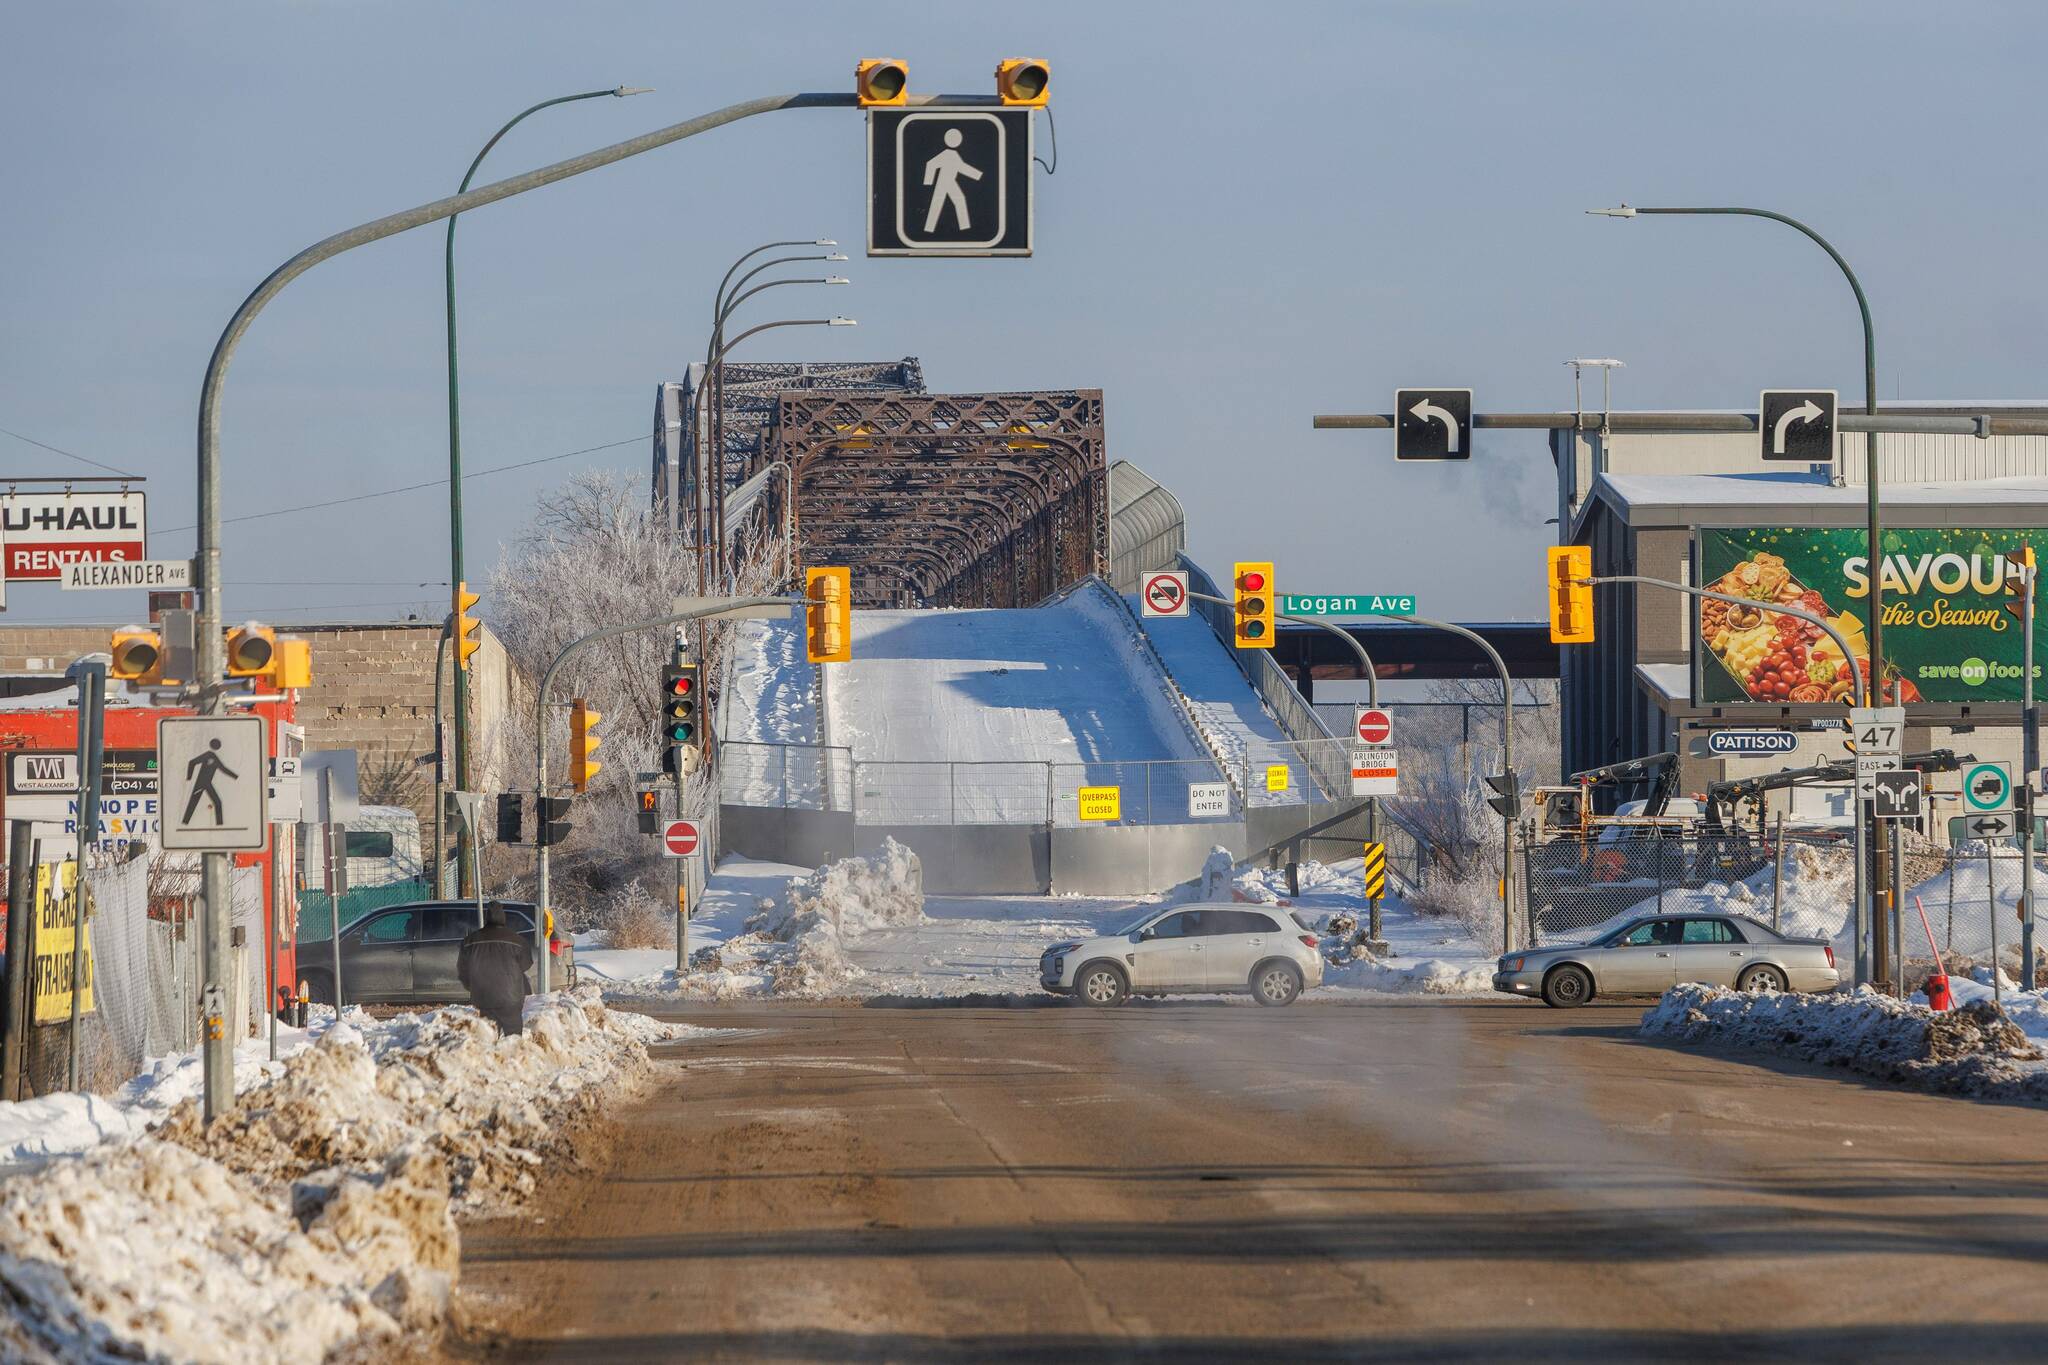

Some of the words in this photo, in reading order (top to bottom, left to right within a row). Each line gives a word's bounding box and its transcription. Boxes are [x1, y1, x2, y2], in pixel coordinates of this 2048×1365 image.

[3, 506, 137, 531] U-HAUL
[72, 564, 164, 586] ALEXANDER
[169, 569, 185, 579] AVE
[1288, 596, 1357, 614] Logan
[1371, 596, 1411, 610] Ave
[1880, 602, 1914, 625] the
[1917, 599, 2007, 632] Season
[1988, 661, 2042, 678] foos
[1861, 727, 1896, 747] 47
[1716, 736, 1791, 749] PATTISON
[1354, 752, 1395, 760] ARLINGTON
[1361, 760, 1387, 768] BRIDGE
[1860, 761, 1880, 771] EAST
[1358, 769, 1392, 777] CLOSED
[111, 780, 142, 790] (204)
[1081, 793, 1117, 802] OVERPASS
[1193, 790, 1205, 798] DO
[1208, 789, 1226, 797] NOT
[1087, 805, 1112, 814] CLOSED
[1196, 802, 1223, 810] ENTER
